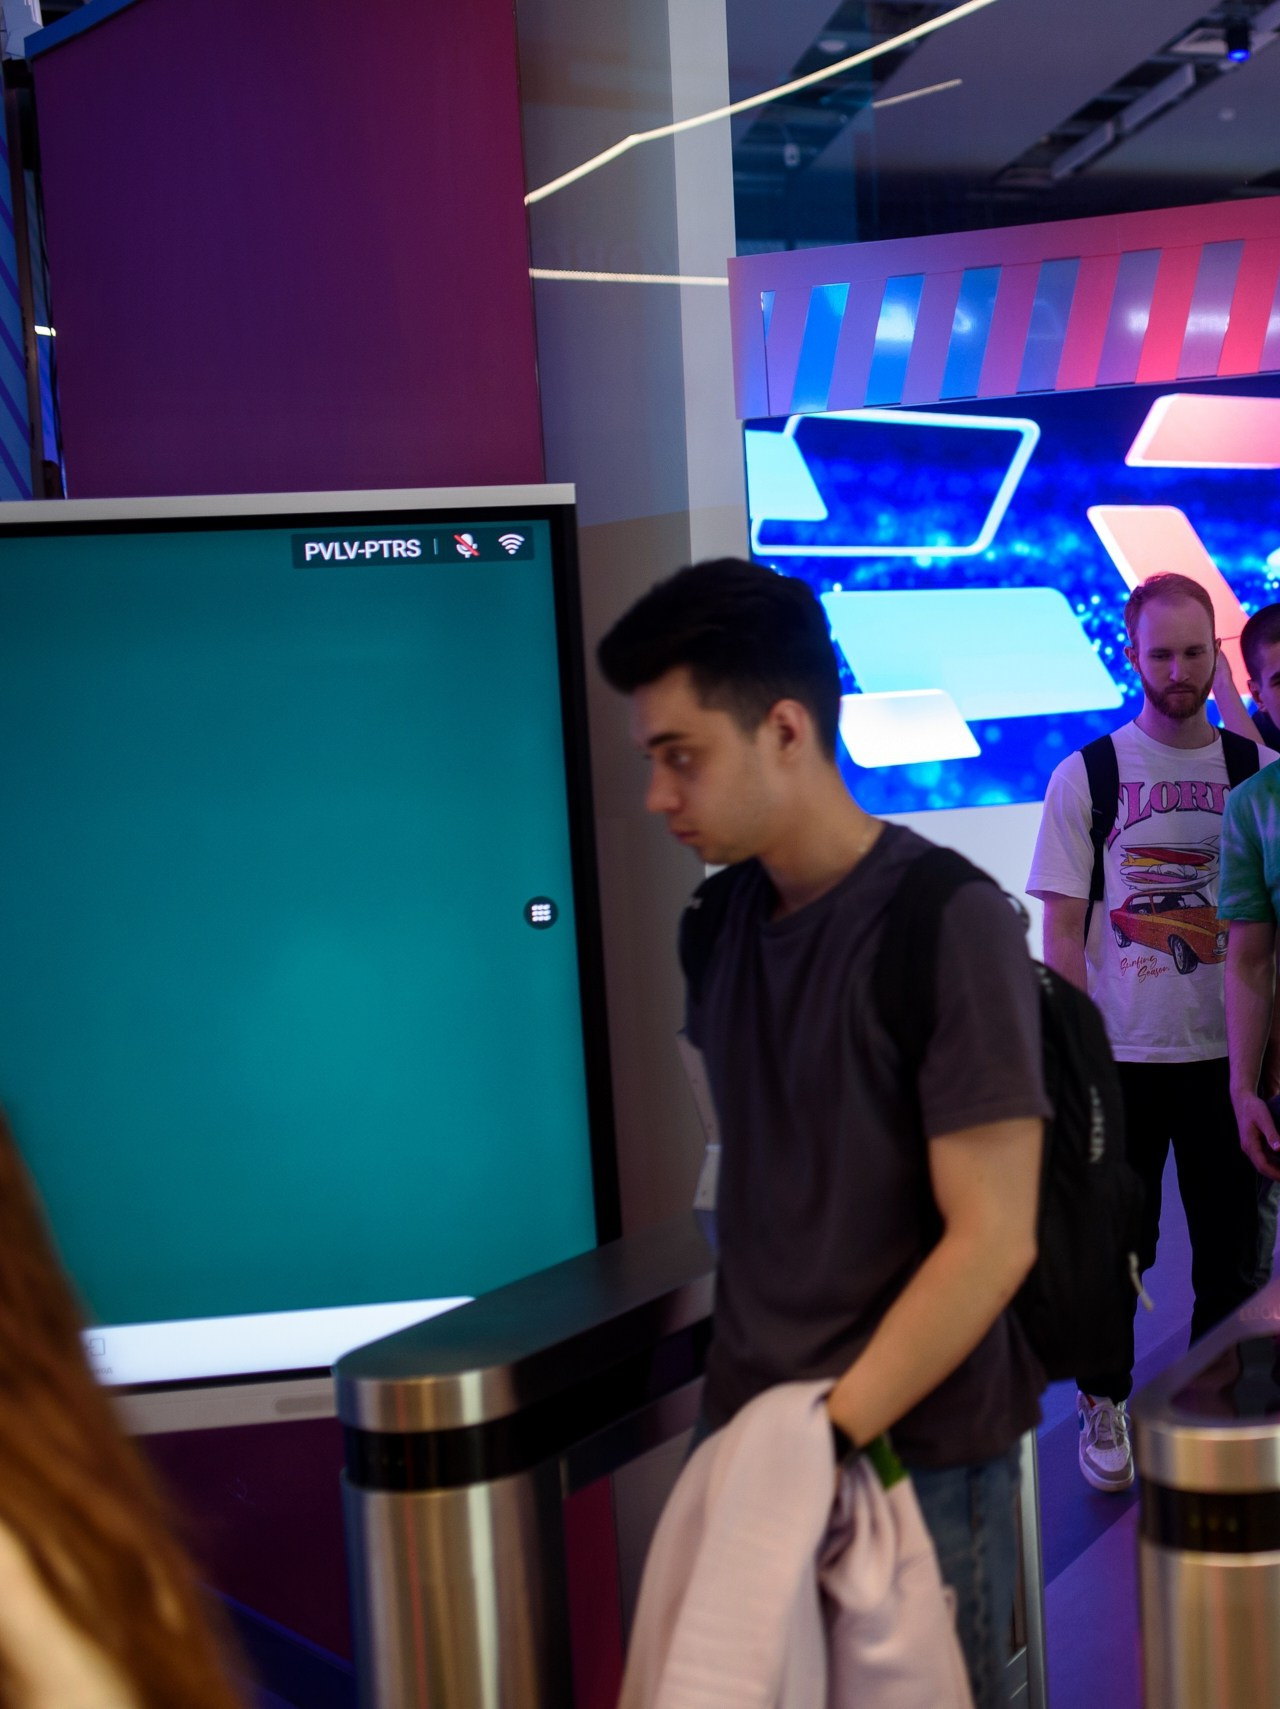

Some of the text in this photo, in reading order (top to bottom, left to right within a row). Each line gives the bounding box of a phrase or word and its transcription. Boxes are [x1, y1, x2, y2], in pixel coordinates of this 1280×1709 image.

[304, 538, 422, 561] PVLV-PTRS
[1120, 955, 1157, 976] Surfing
[1137, 965, 1170, 984] Season
